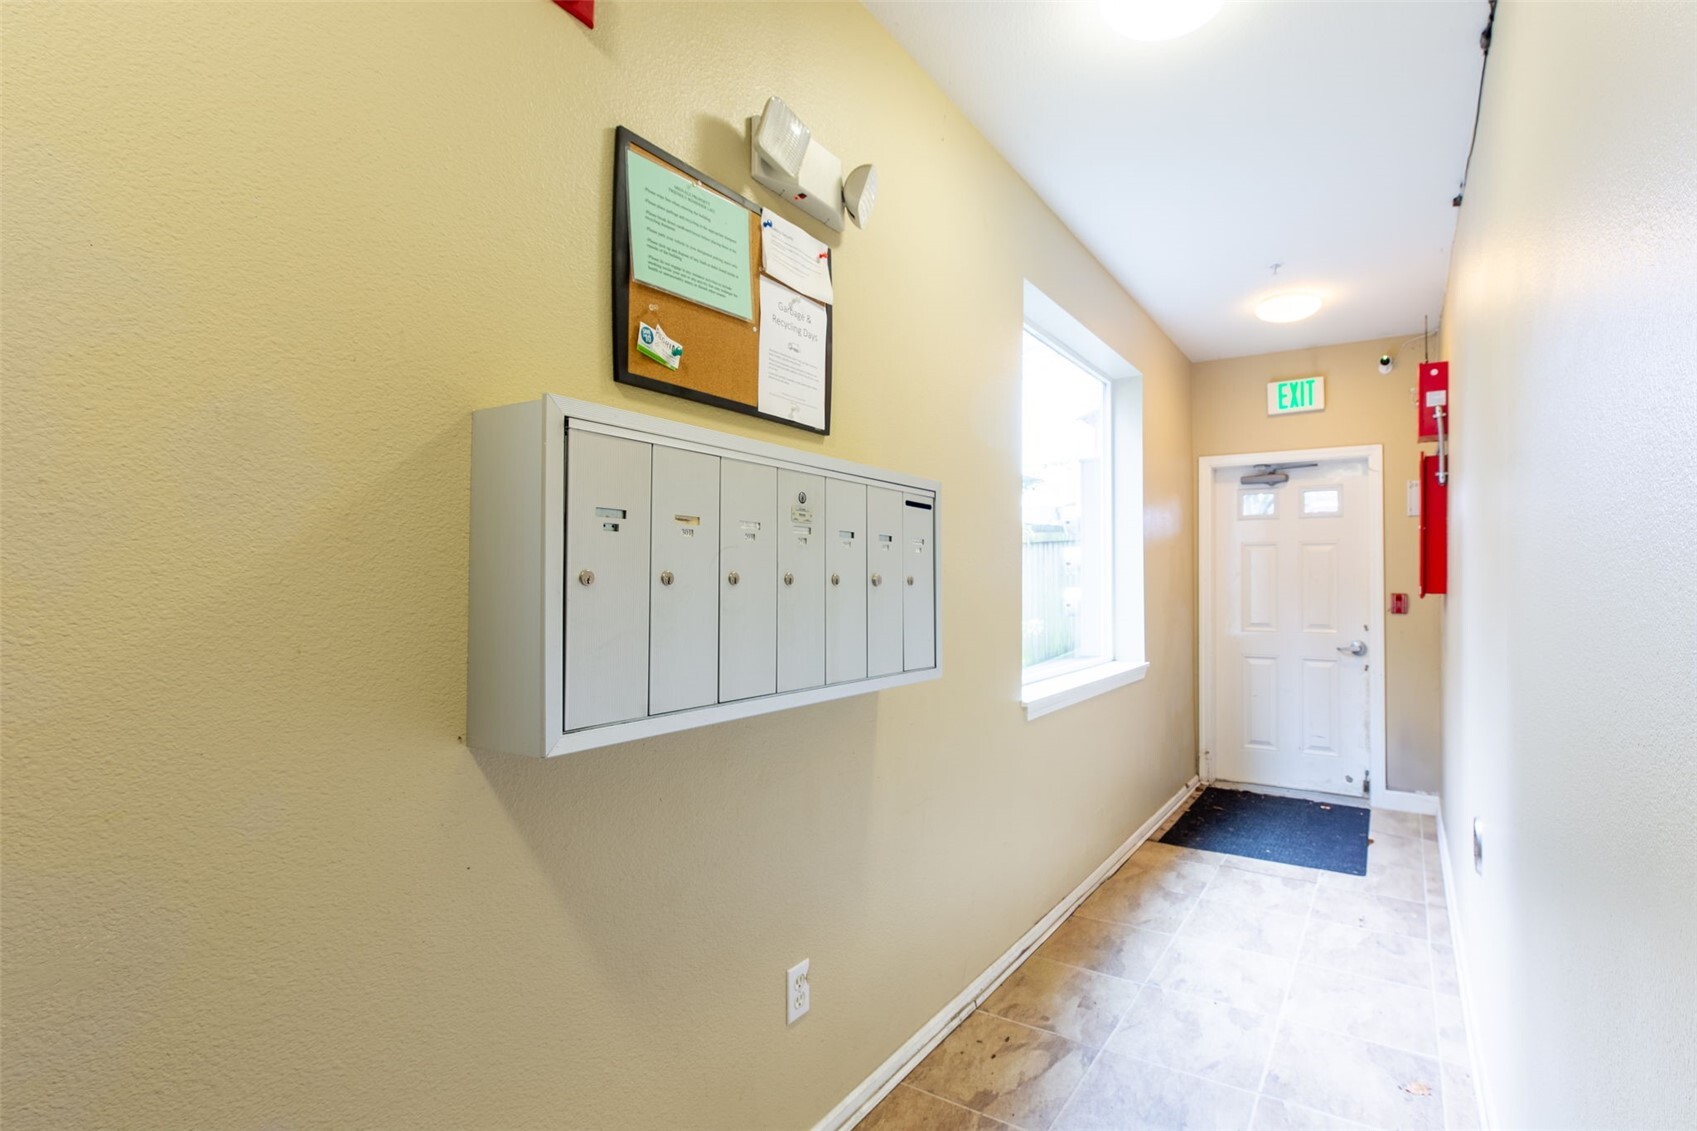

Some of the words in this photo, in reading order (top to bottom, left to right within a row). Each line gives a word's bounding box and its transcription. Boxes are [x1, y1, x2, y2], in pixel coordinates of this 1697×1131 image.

[777, 301, 805, 321] Garbage
[806, 314, 812, 324] &
[772, 314, 802, 337] Recycling
[803, 328, 818, 342] Days
[1278, 379, 1315, 410] EXIT
